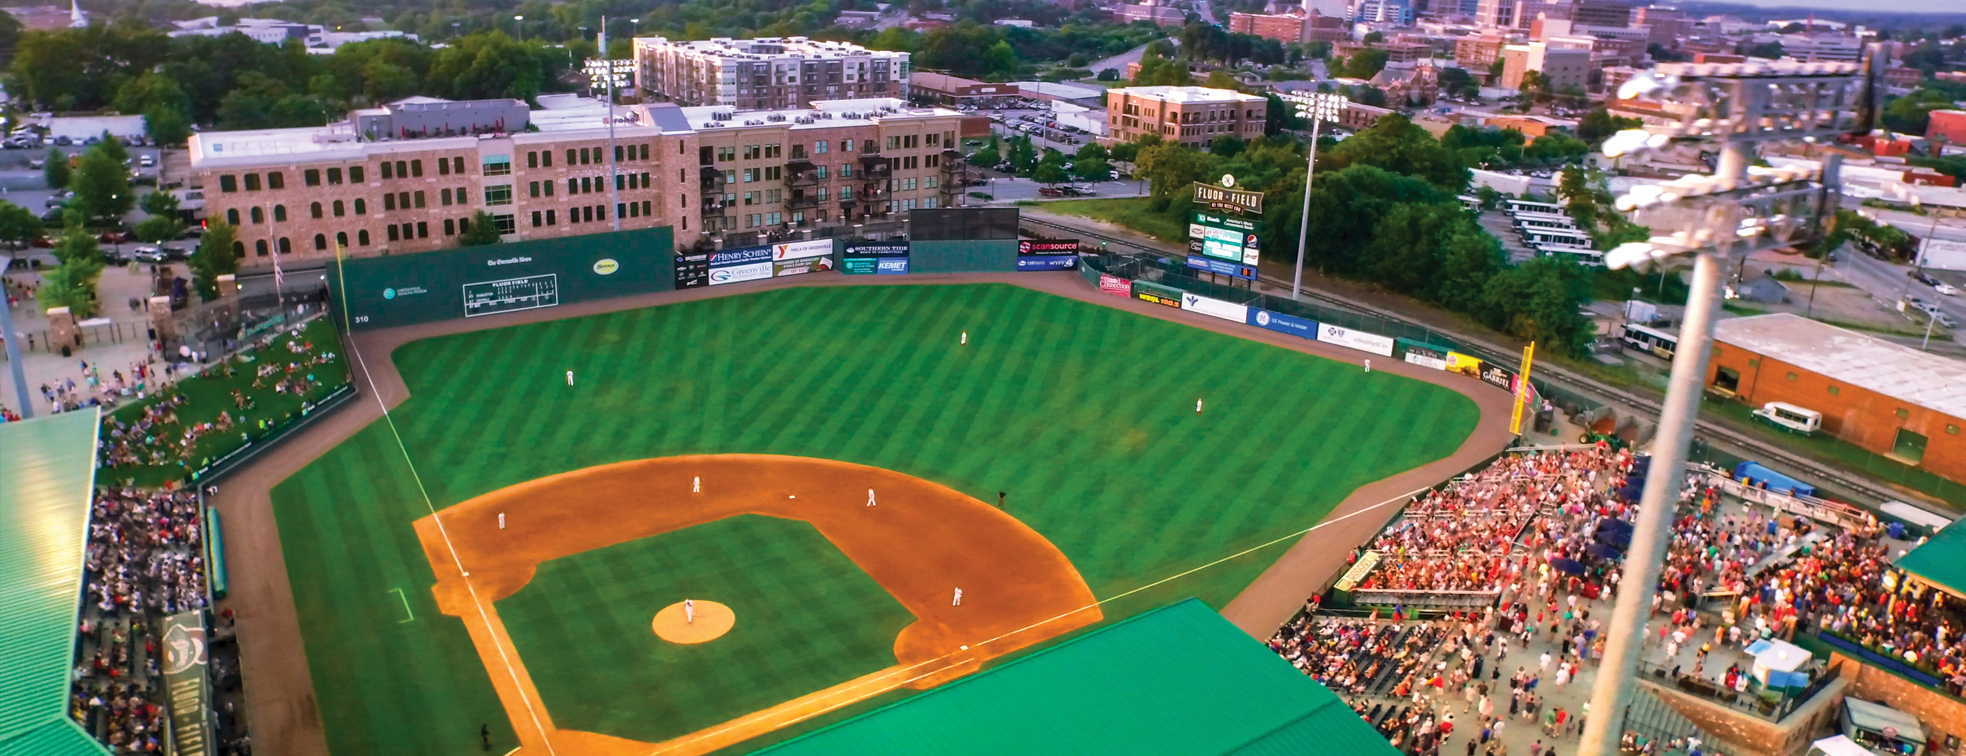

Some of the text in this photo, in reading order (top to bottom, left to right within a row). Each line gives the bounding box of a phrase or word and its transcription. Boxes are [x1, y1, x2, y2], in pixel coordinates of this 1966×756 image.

[1198, 187, 1256, 208] FLUOR FIELD
[717, 252, 742, 261] HENRY
[732, 265, 771, 276] Greenville
[1160, 298, 1180, 308] 100.5
[1482, 372, 1509, 387] GABRIEL
